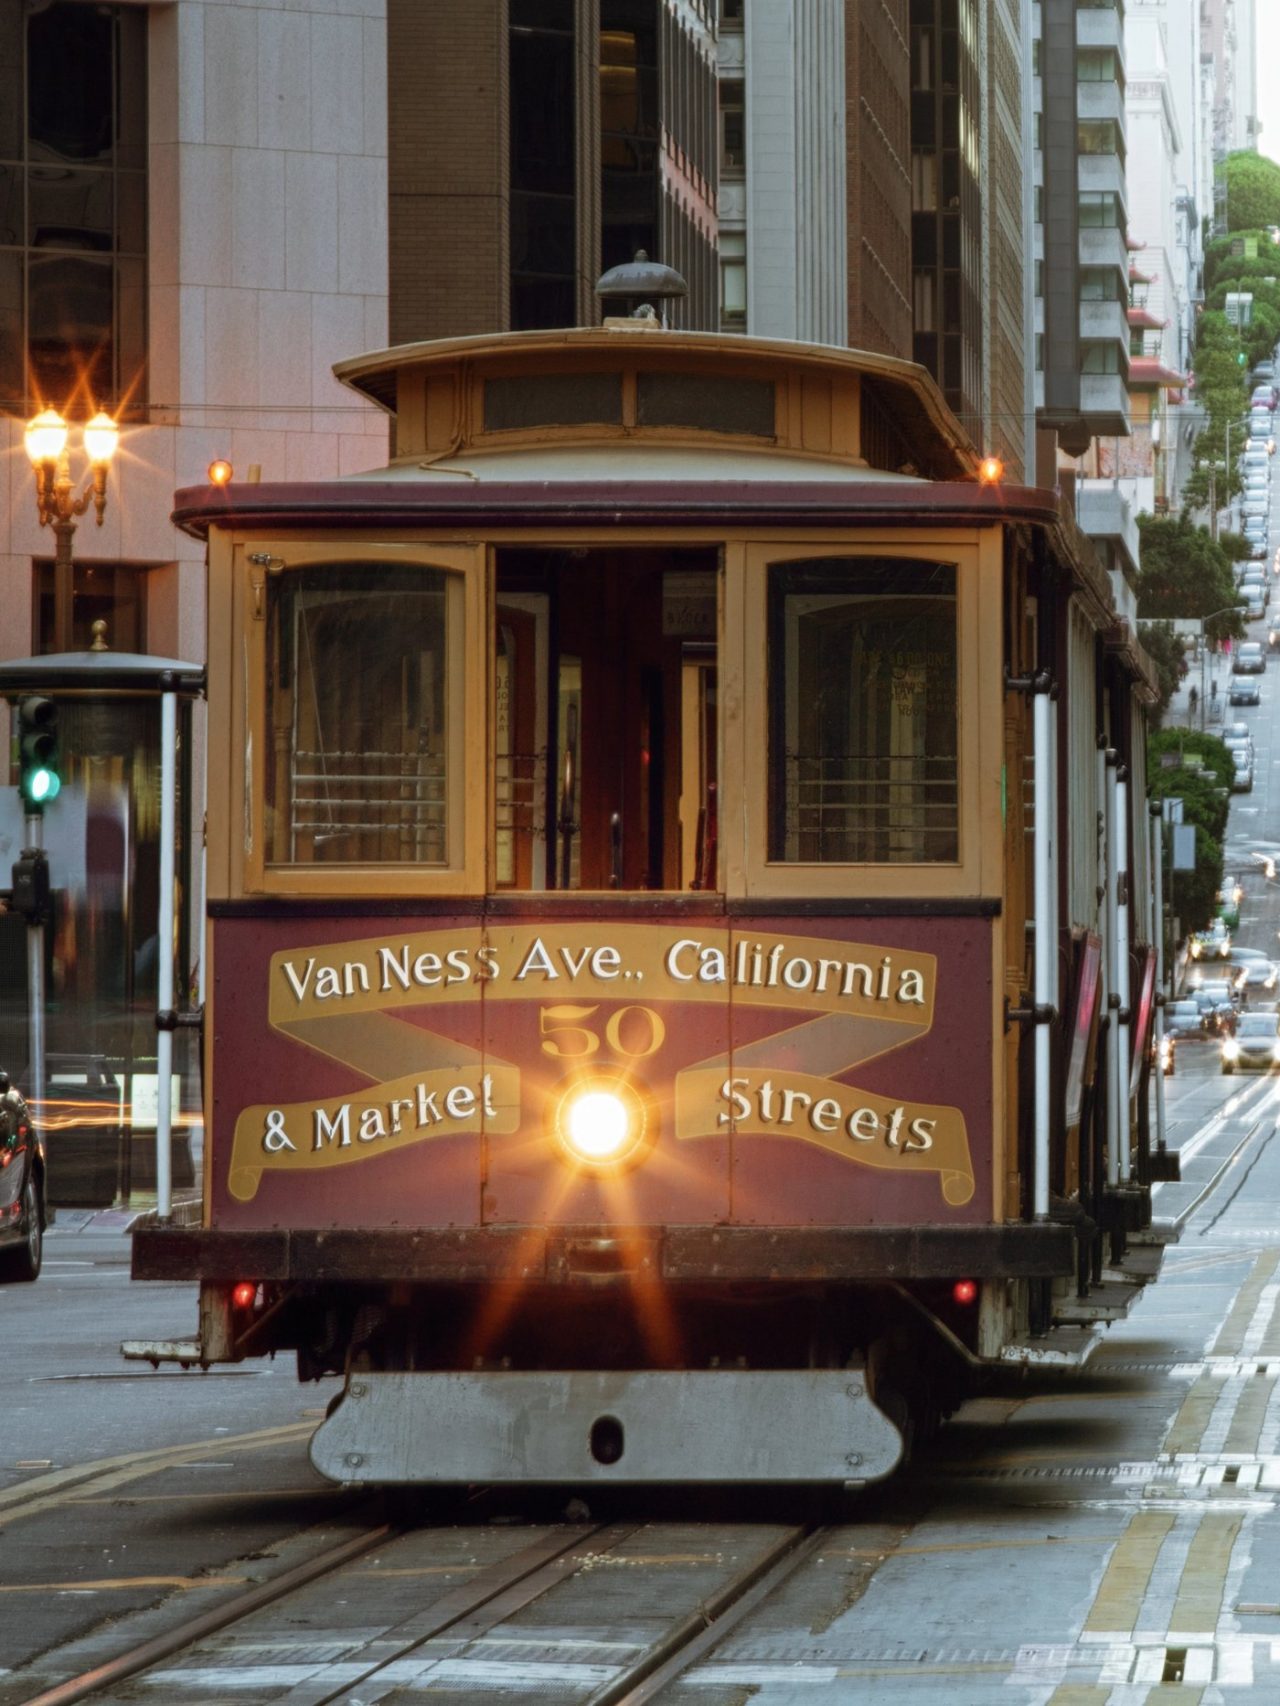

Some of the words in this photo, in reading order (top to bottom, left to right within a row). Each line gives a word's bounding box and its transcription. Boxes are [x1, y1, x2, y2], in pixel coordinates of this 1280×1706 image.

[282, 957, 370, 1001] Van
[378, 944, 500, 990] Ness
[666, 939, 926, 1005] California
[540, 1003, 666, 1058] 50
[263, 1109, 297, 1152] &
[313, 1072, 498, 1149] Market
[717, 1077, 937, 1152] Streets
